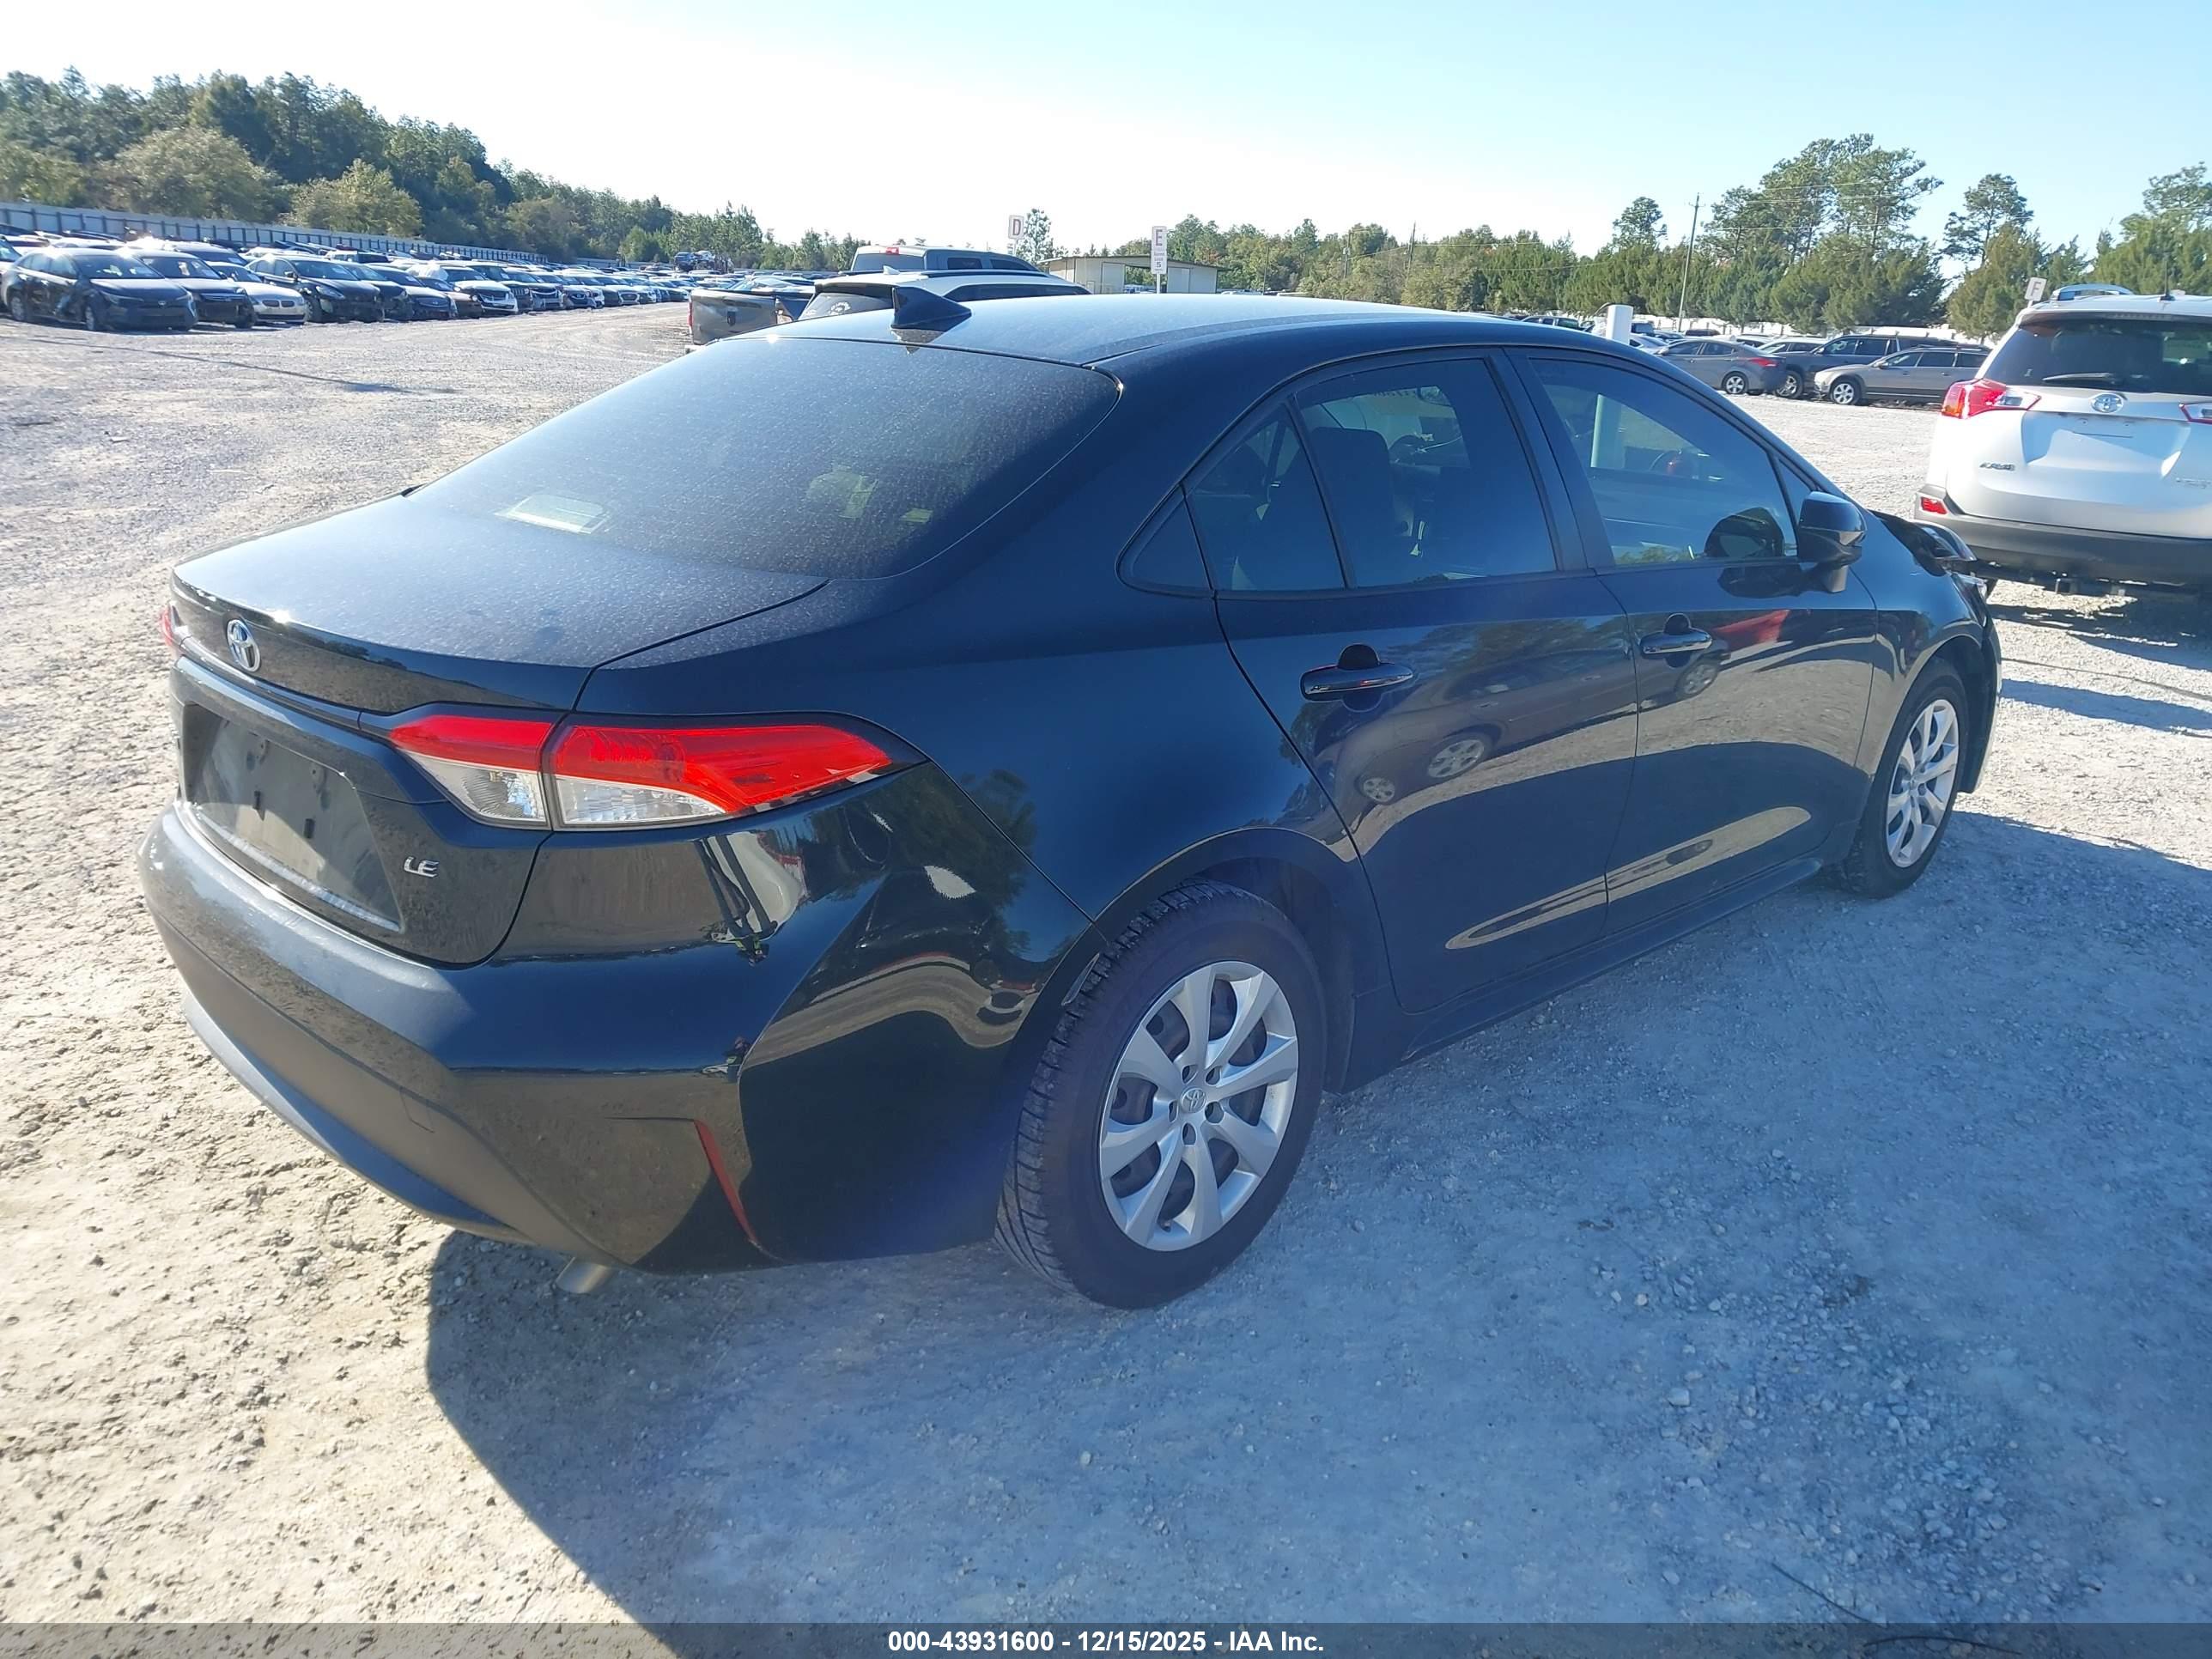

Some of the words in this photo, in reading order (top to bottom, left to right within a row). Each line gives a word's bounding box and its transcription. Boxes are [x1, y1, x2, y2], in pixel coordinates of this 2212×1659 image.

[1012, 218, 1022, 236] D
[1155, 229, 1163, 246] E
[2030, 281, 2042, 296] F
[404, 856, 440, 878] LE
